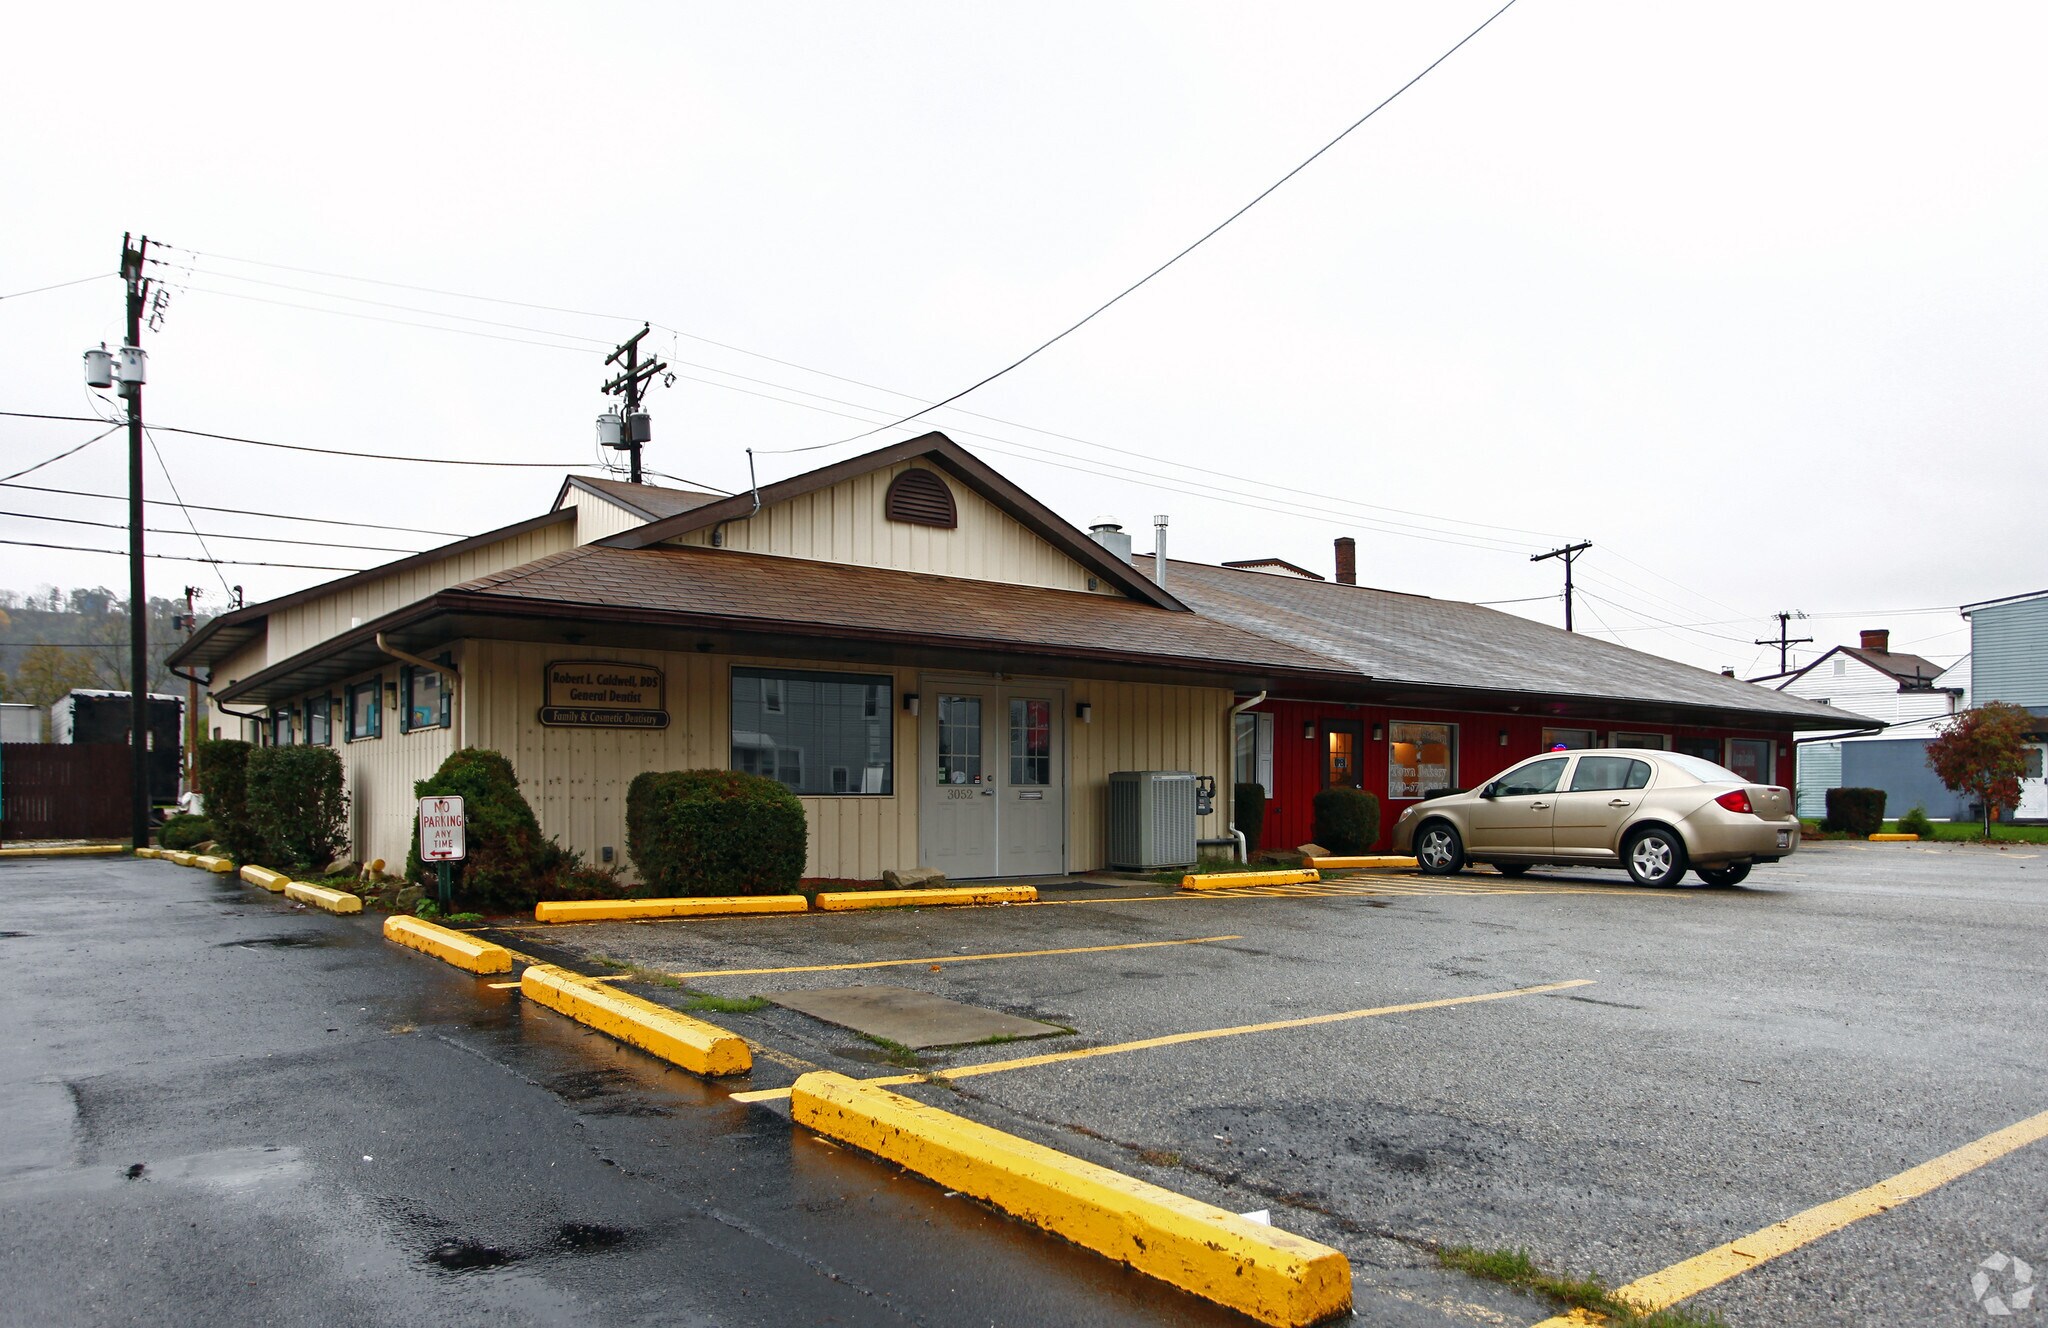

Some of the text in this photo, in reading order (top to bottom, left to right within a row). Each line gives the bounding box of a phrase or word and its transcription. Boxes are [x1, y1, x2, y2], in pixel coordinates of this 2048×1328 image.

[553, 672, 585, 685] Robert
[597, 673, 637, 688] Caldwell,
[640, 676, 658, 688] DDS
[570, 688, 642, 703] General Dentist
[553, 710, 657, 726] Family & Cosmetic Dentistry
[1417, 764, 1447, 781] Bakery
[947, 789, 973, 800] 3052
[434, 800, 450, 813] NO
[424, 815, 462, 827] PARKING
[435, 830, 452, 838] ANY
[433, 839, 453, 848] TIME
